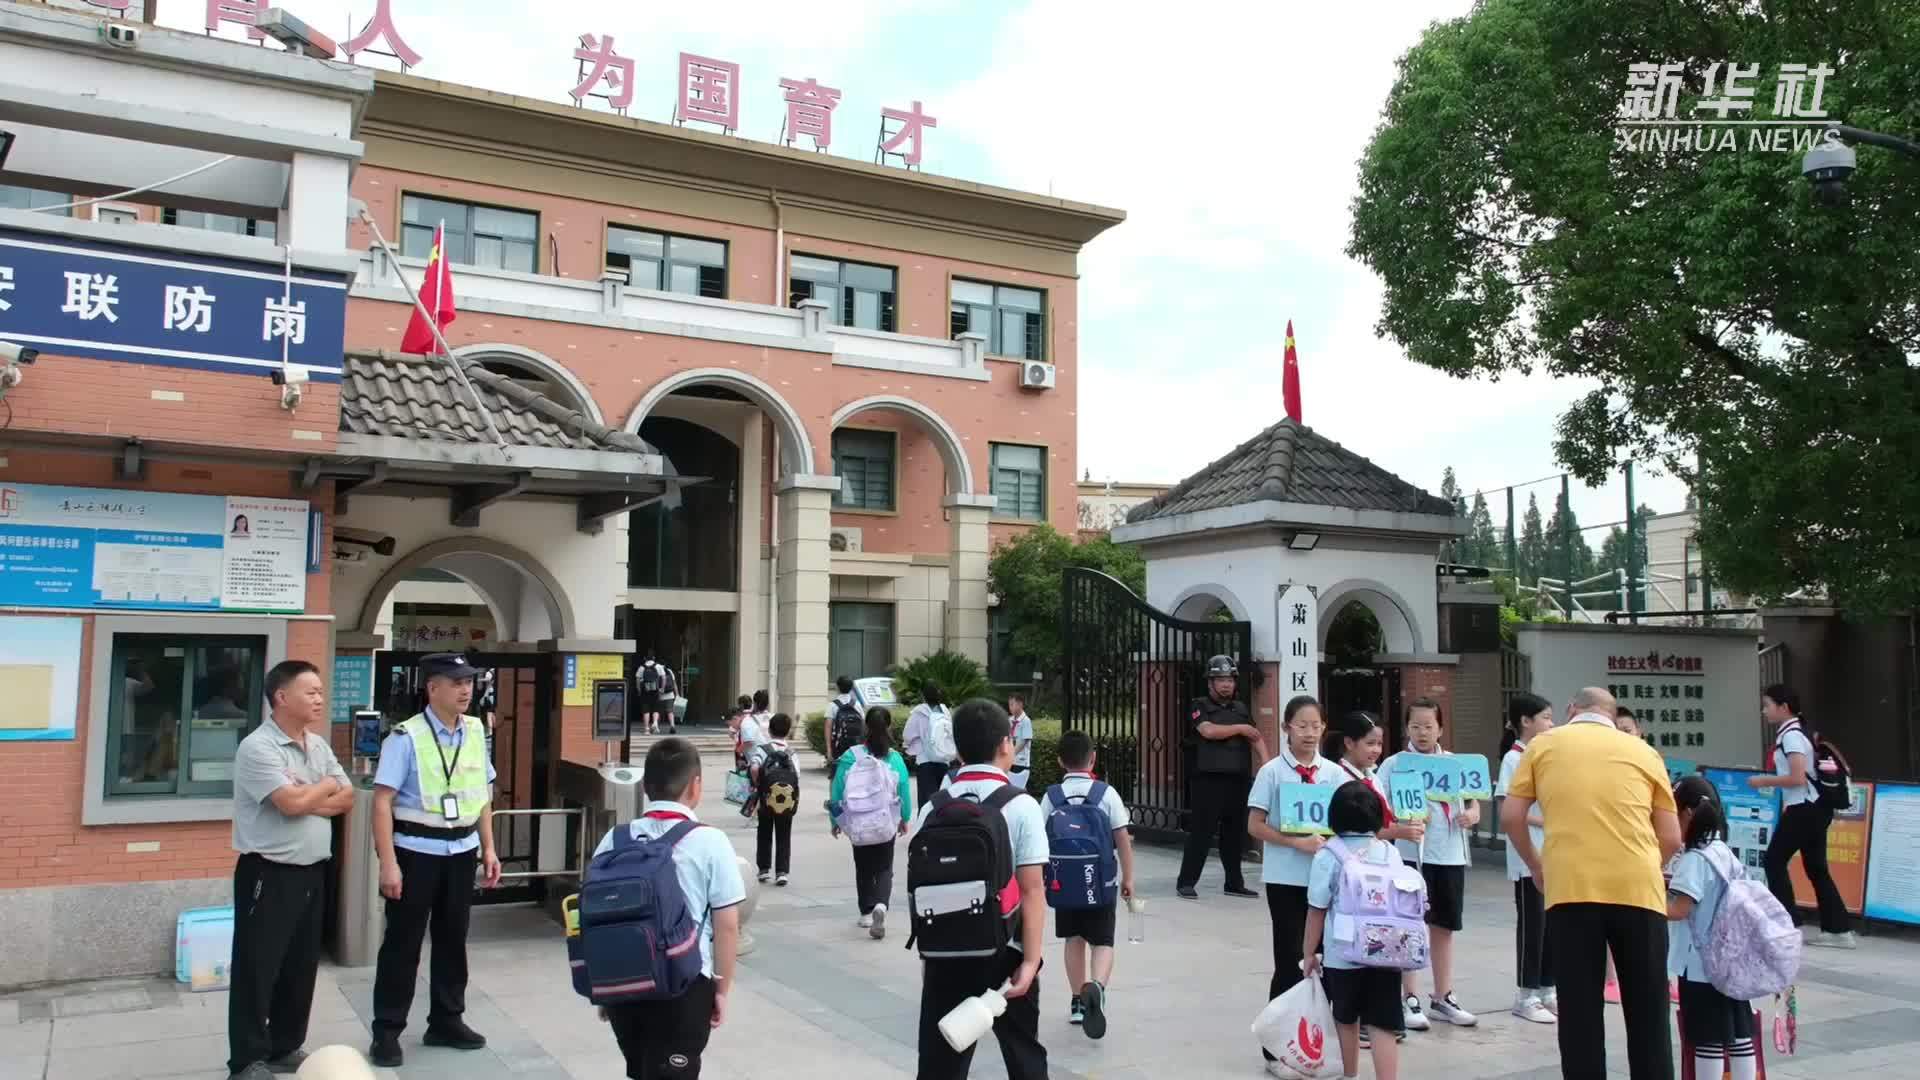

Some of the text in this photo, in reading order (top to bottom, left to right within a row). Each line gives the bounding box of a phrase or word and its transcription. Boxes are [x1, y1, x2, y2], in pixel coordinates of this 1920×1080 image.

[568, 32, 937, 166] 为国育才
[0, 266, 307, 346] 联防岗
[1291, 602, 1308, 692] 萧山区
[1634, 684, 1655, 699] 民主
[1660, 684, 1679, 699] 文明
[1660, 708, 1680, 722] 公正
[1686, 733, 1705, 747] 友善
[1422, 770, 1450, 793] 04
[1396, 788, 1423, 810] 105
[1293, 800, 1325, 824] 10
